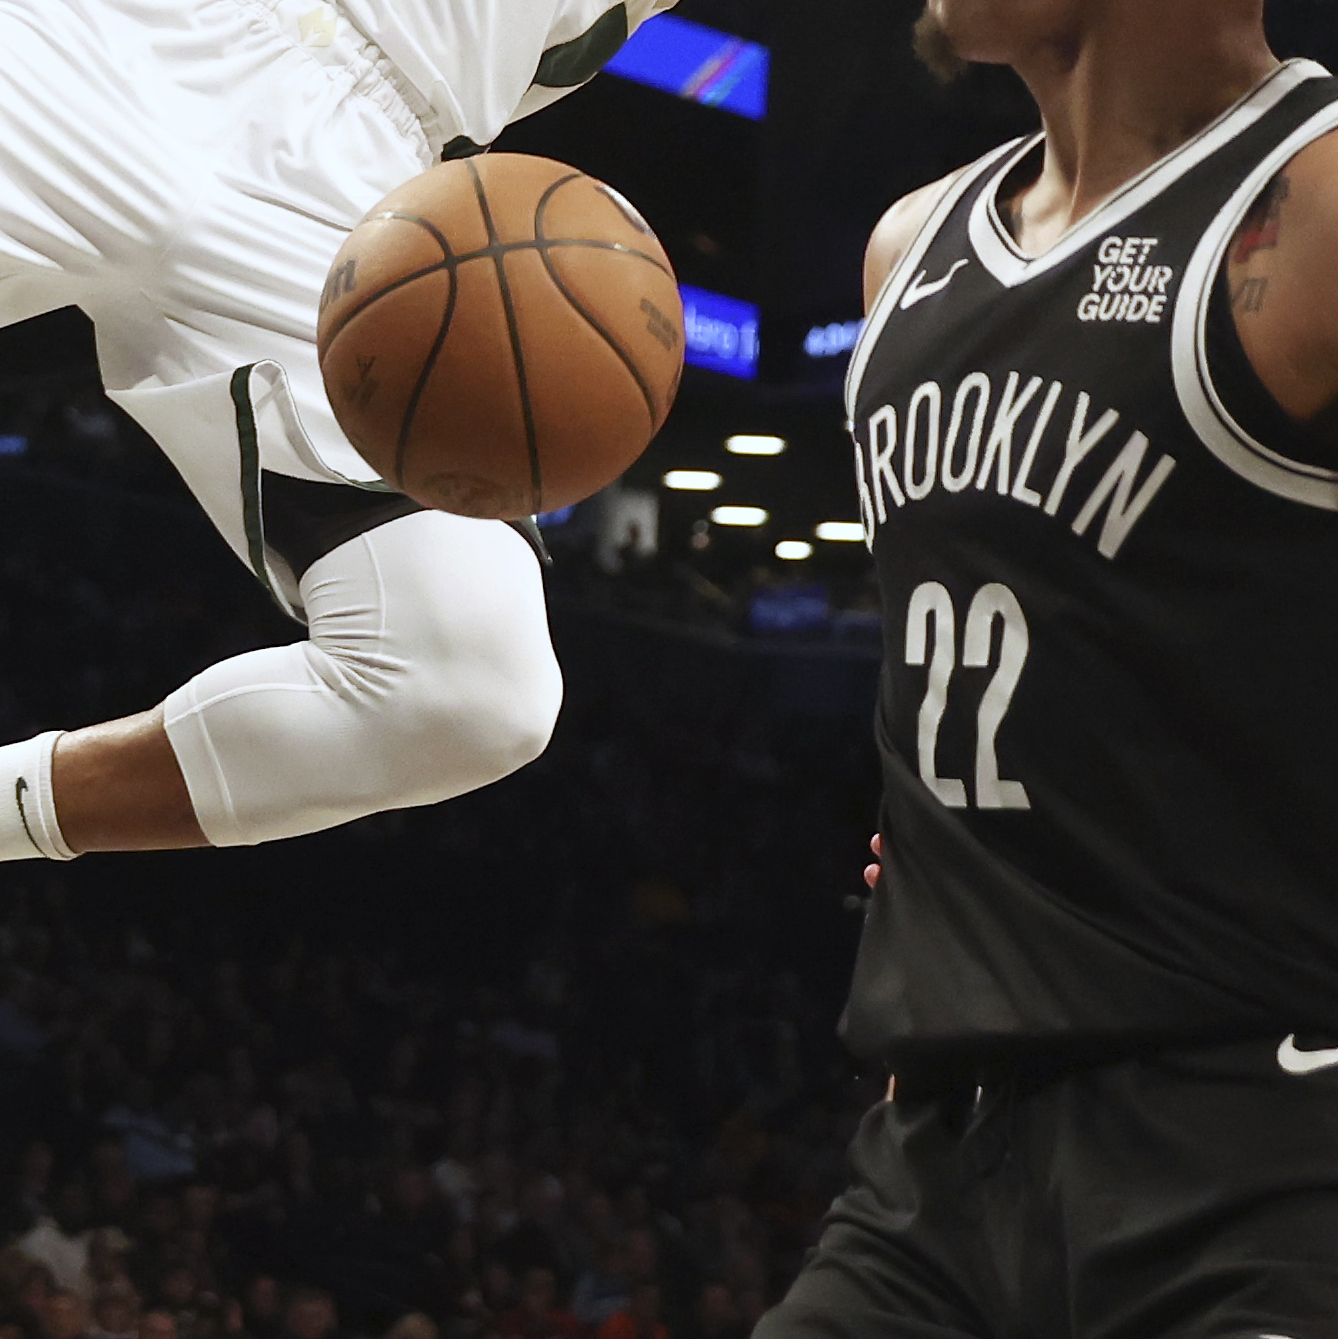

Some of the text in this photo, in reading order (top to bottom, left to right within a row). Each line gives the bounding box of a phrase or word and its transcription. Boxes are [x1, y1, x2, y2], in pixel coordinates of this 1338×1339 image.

[1097, 236, 1159, 265] GET
[1092, 264, 1174, 294] YOUR
[1077, 292, 1168, 324] GUIDE
[905, 581, 1031, 810] 22
